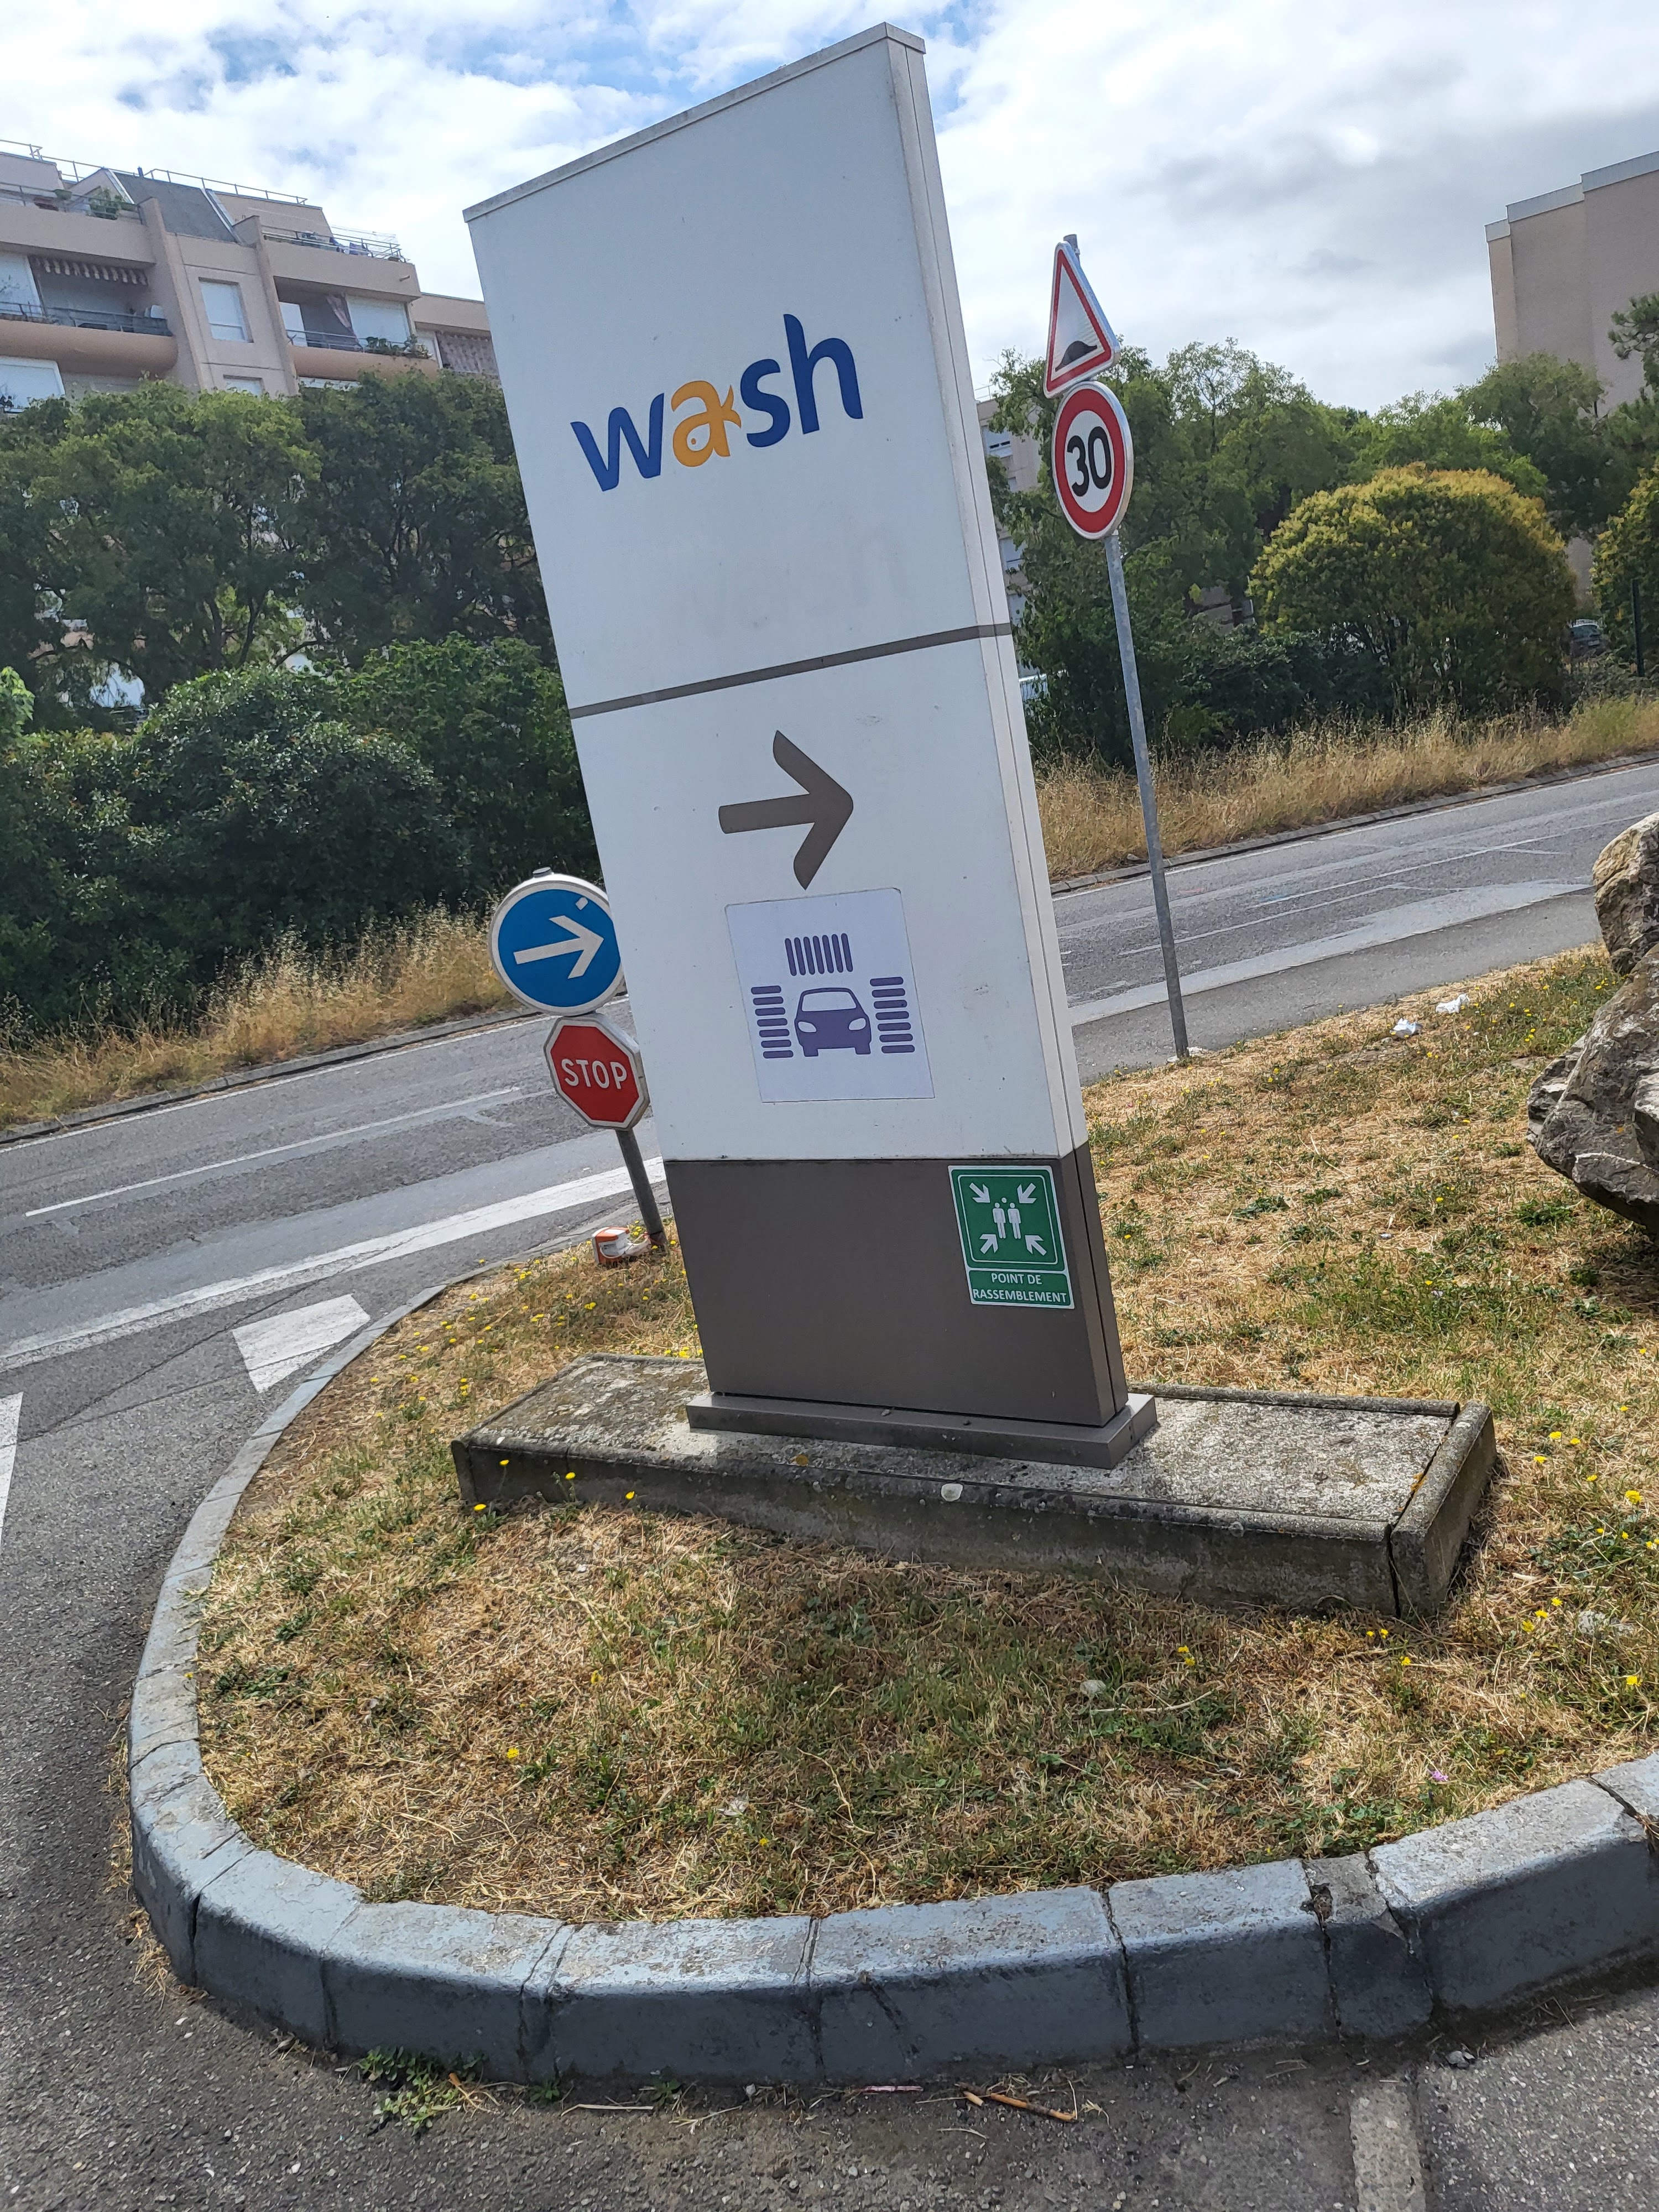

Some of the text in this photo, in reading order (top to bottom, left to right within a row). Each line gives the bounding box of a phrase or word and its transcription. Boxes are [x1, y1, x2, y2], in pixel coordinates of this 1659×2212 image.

[571, 314, 863, 492] wash
[1067, 426, 1112, 497] 30
[561, 1059, 627, 1089] STOP
[991, 1273, 1042, 1285] POINT DE
[973, 1288, 1067, 1303] RASSEMBLEMENT
